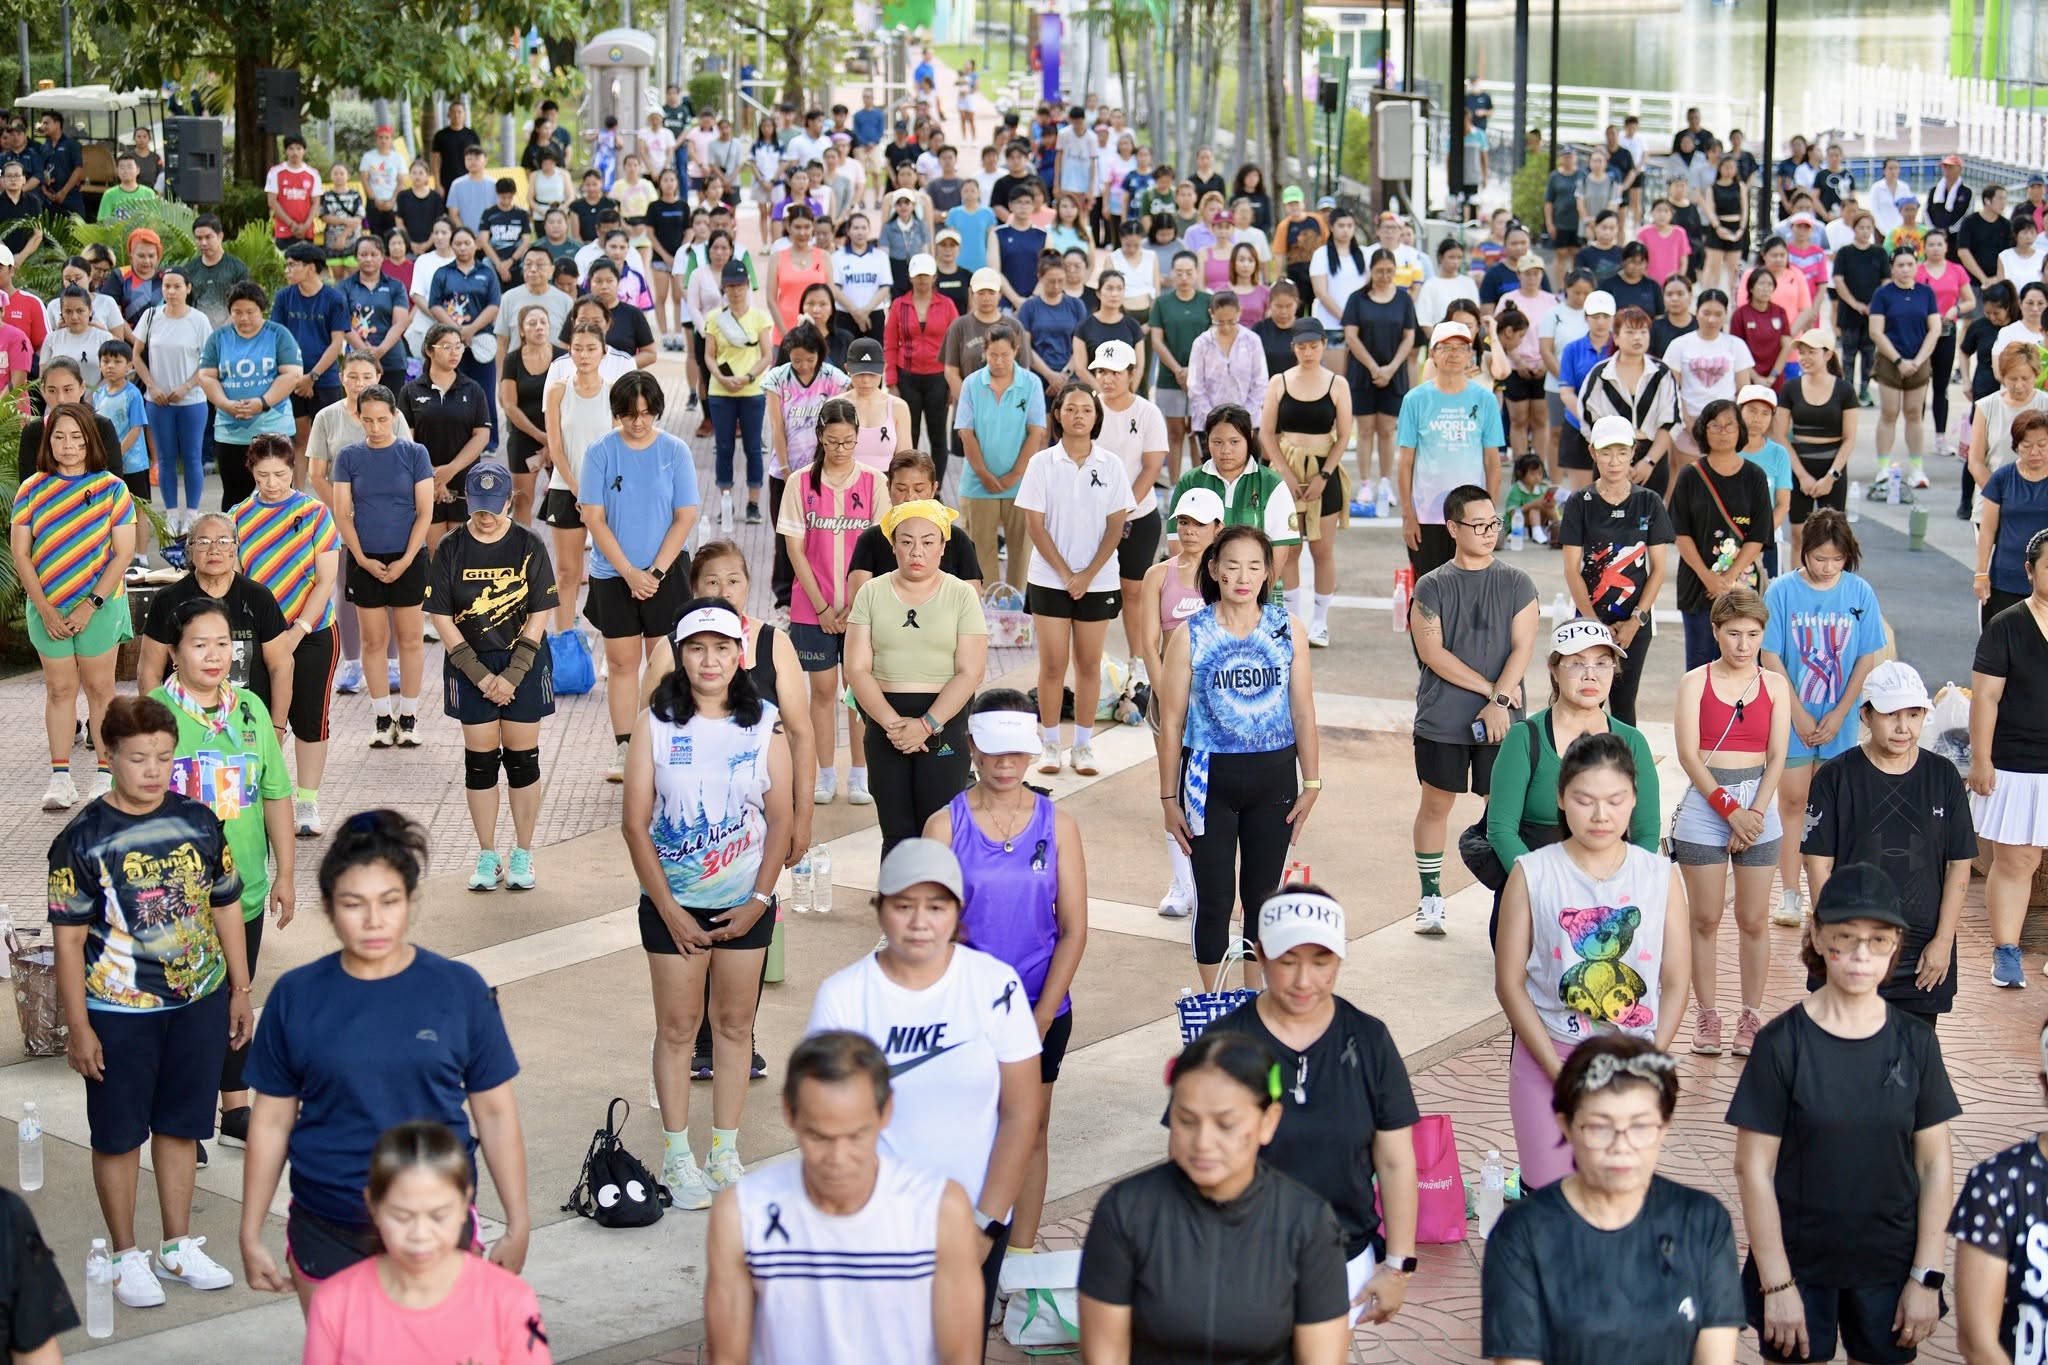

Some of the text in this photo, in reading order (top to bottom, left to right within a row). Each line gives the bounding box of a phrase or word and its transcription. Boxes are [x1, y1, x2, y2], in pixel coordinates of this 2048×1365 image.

[1429, 421, 1476, 431] WORLD
[798, 651, 826, 661] DIDAS
[1212, 667, 1281, 689] AWESOME
[1264, 903, 1341, 929] SPORT
[884, 1023, 948, 1054] NIKE
[2013, 1303, 2048, 1365] D
